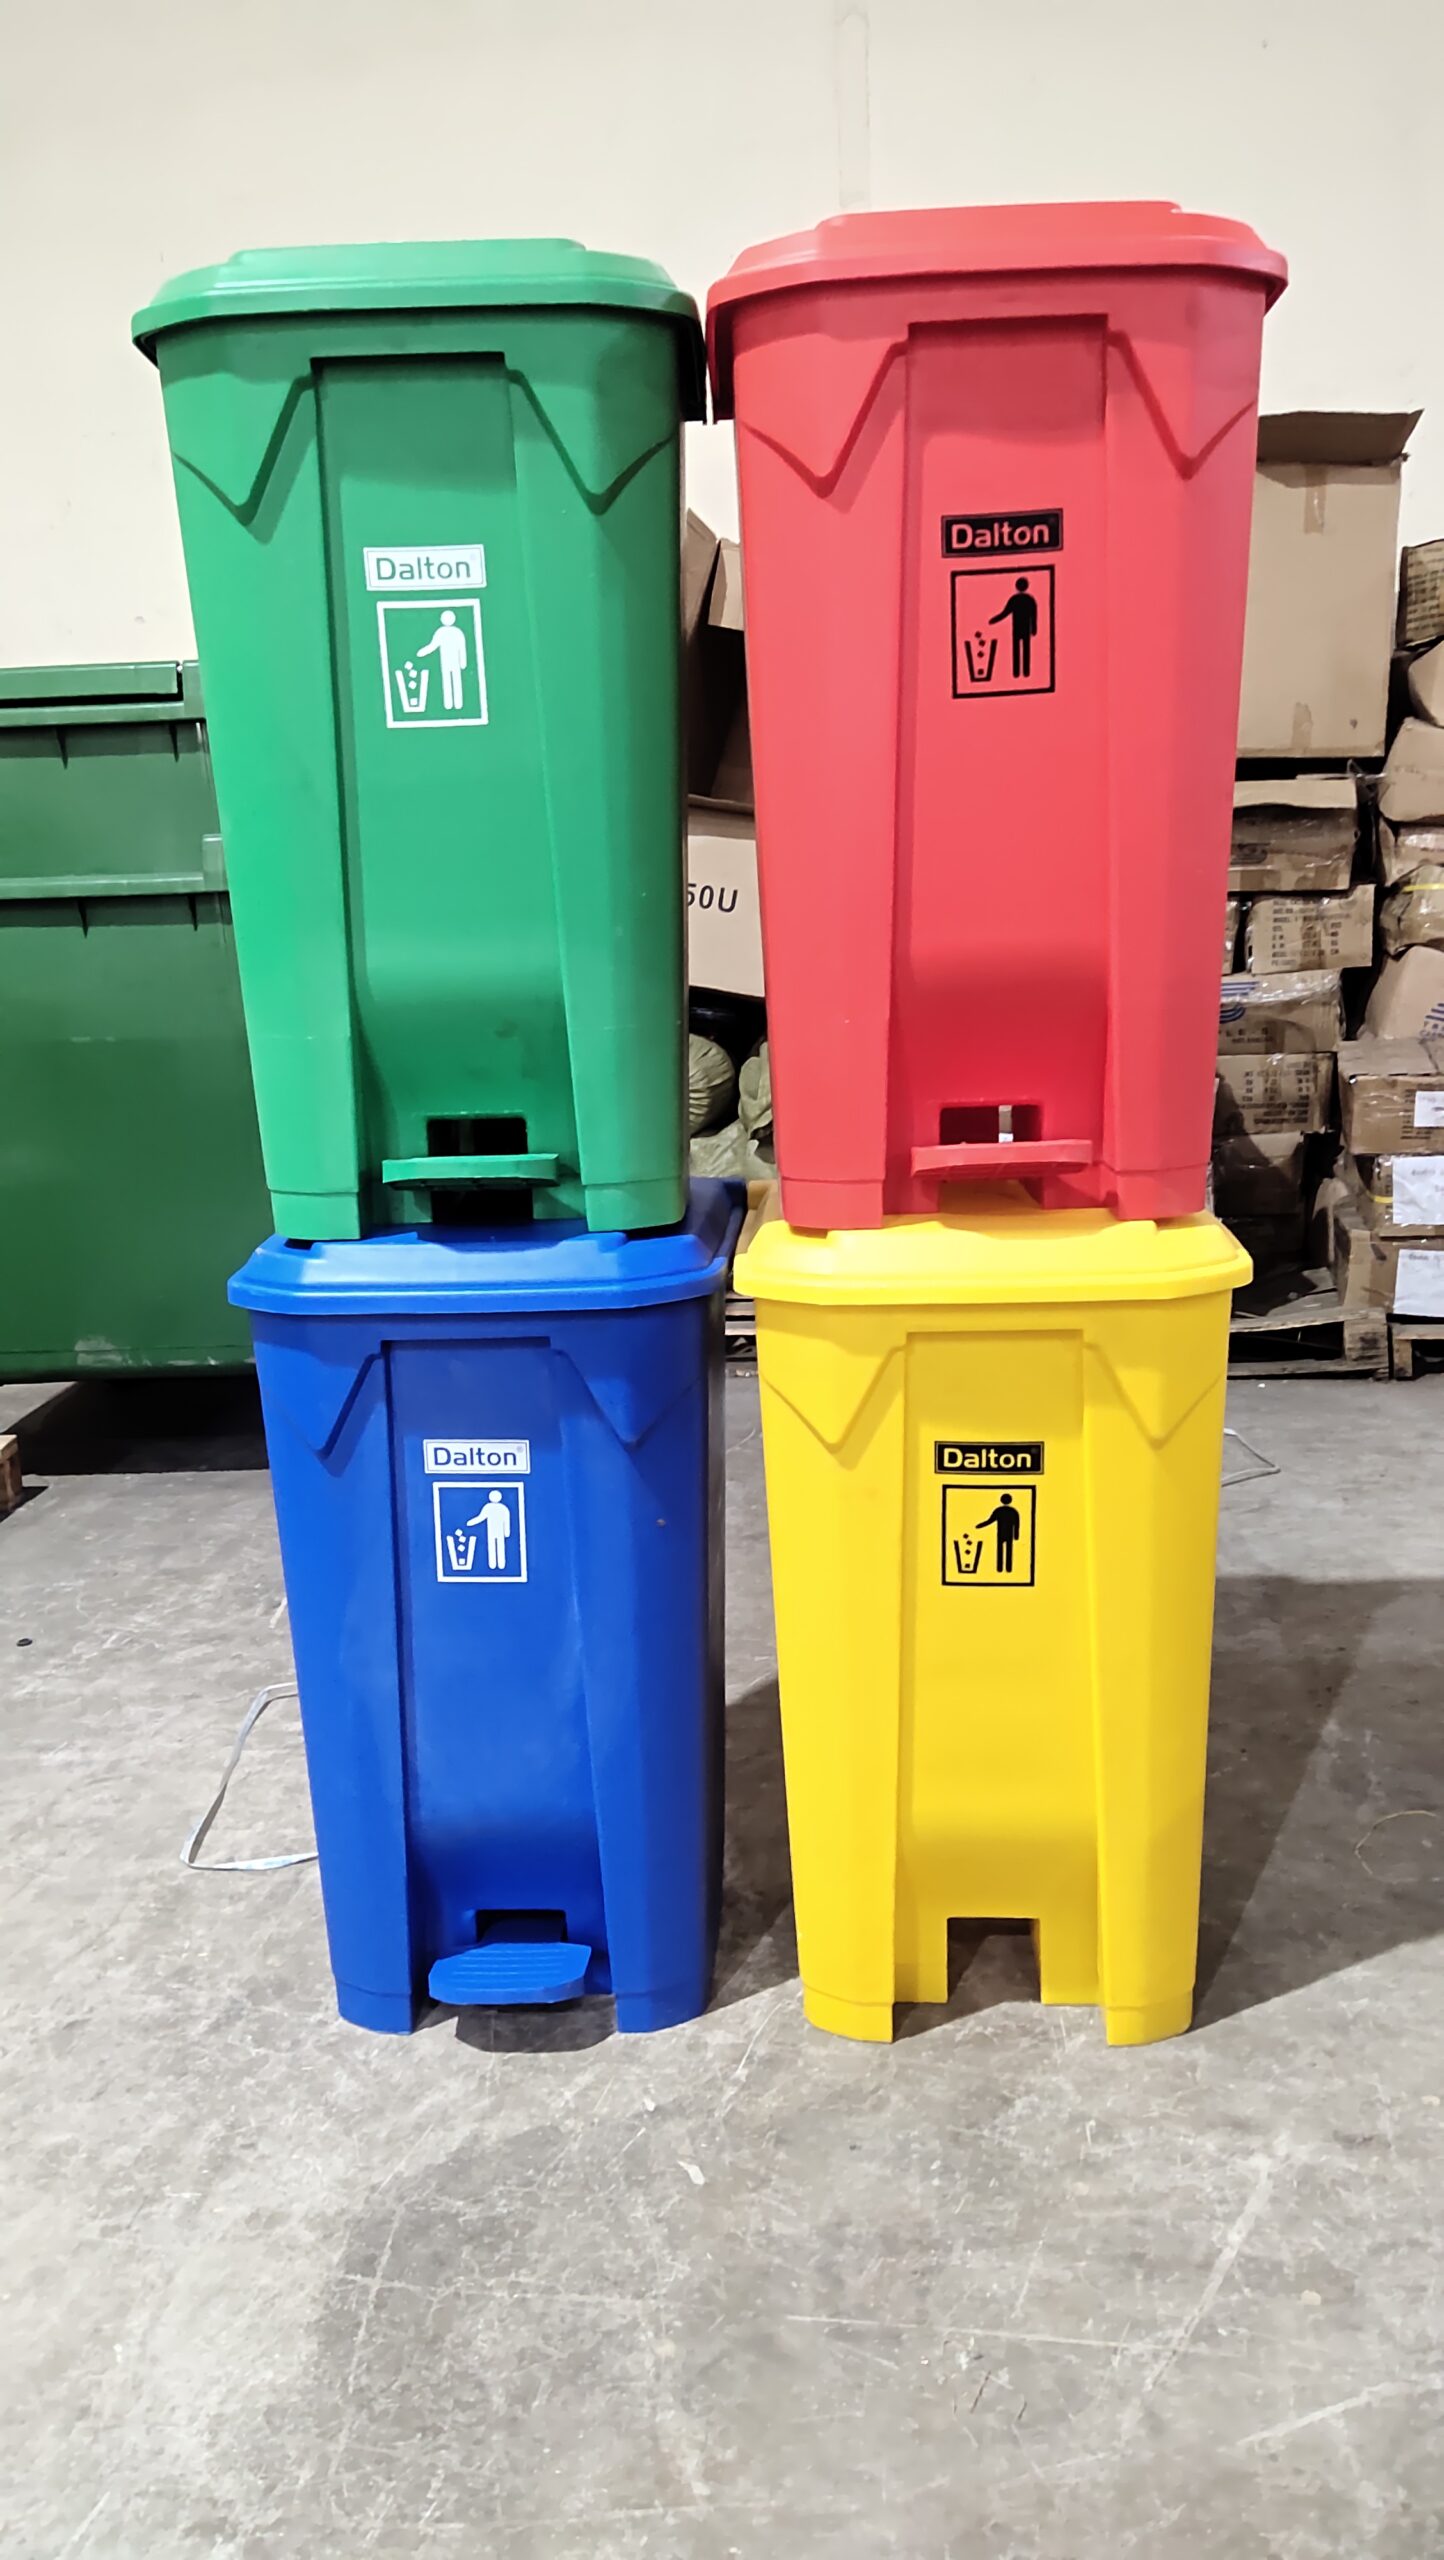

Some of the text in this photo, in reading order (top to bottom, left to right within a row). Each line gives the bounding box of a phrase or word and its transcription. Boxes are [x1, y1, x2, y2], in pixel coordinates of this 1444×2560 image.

[951, 521, 1049, 549] Dalton
[376, 556, 471, 580] Dalton
[433, 1447, 517, 1466] Dalton
[943, 1448, 1032, 1468] Dalton
